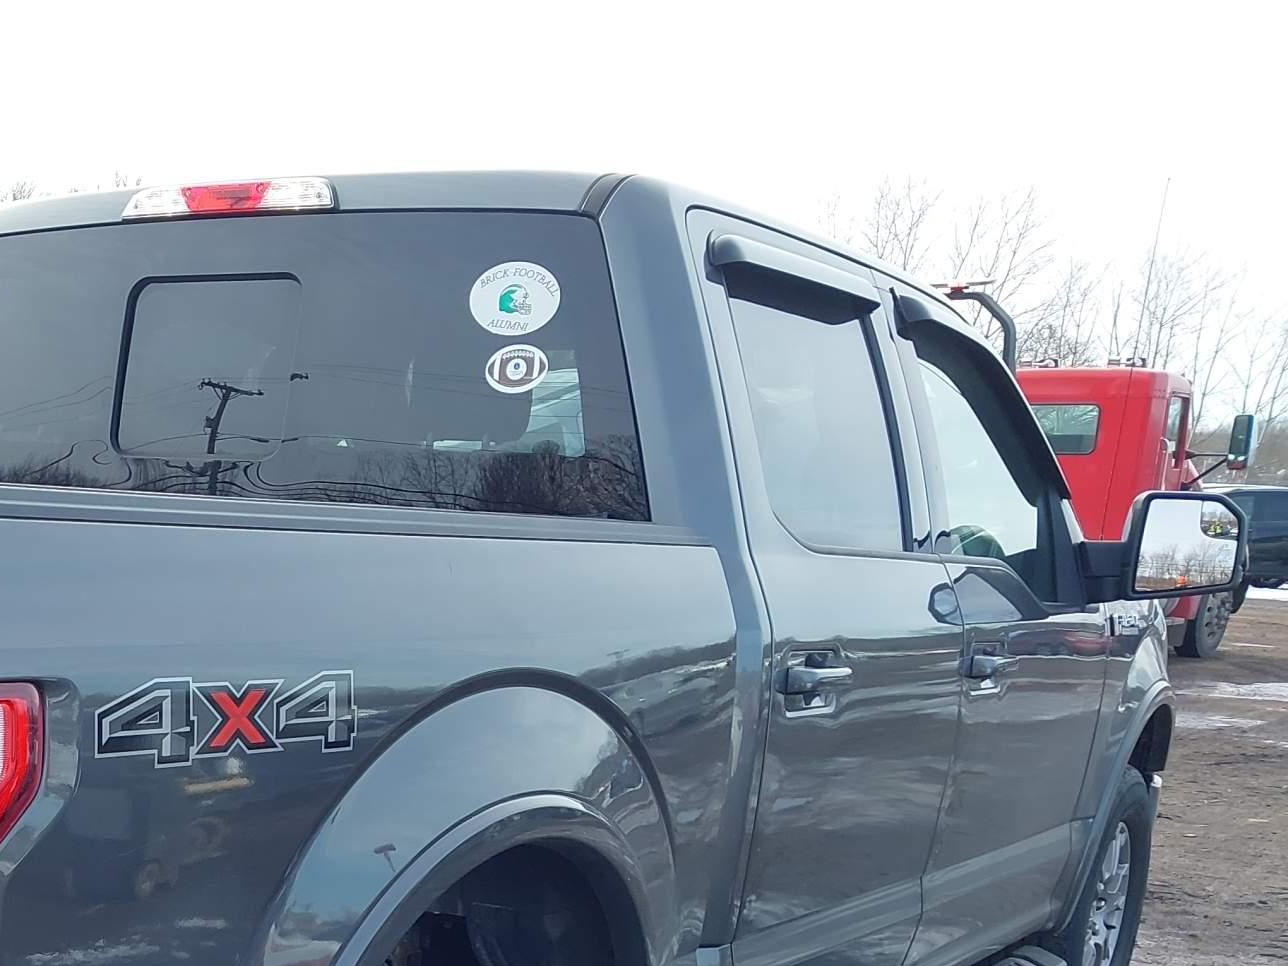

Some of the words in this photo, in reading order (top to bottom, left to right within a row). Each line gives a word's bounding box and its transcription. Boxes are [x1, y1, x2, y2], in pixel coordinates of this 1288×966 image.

[480, 268, 510, 288] BRICK
[513, 267, 559, 297] FOOTBALL
[487, 318, 529, 332] ALUMNI
